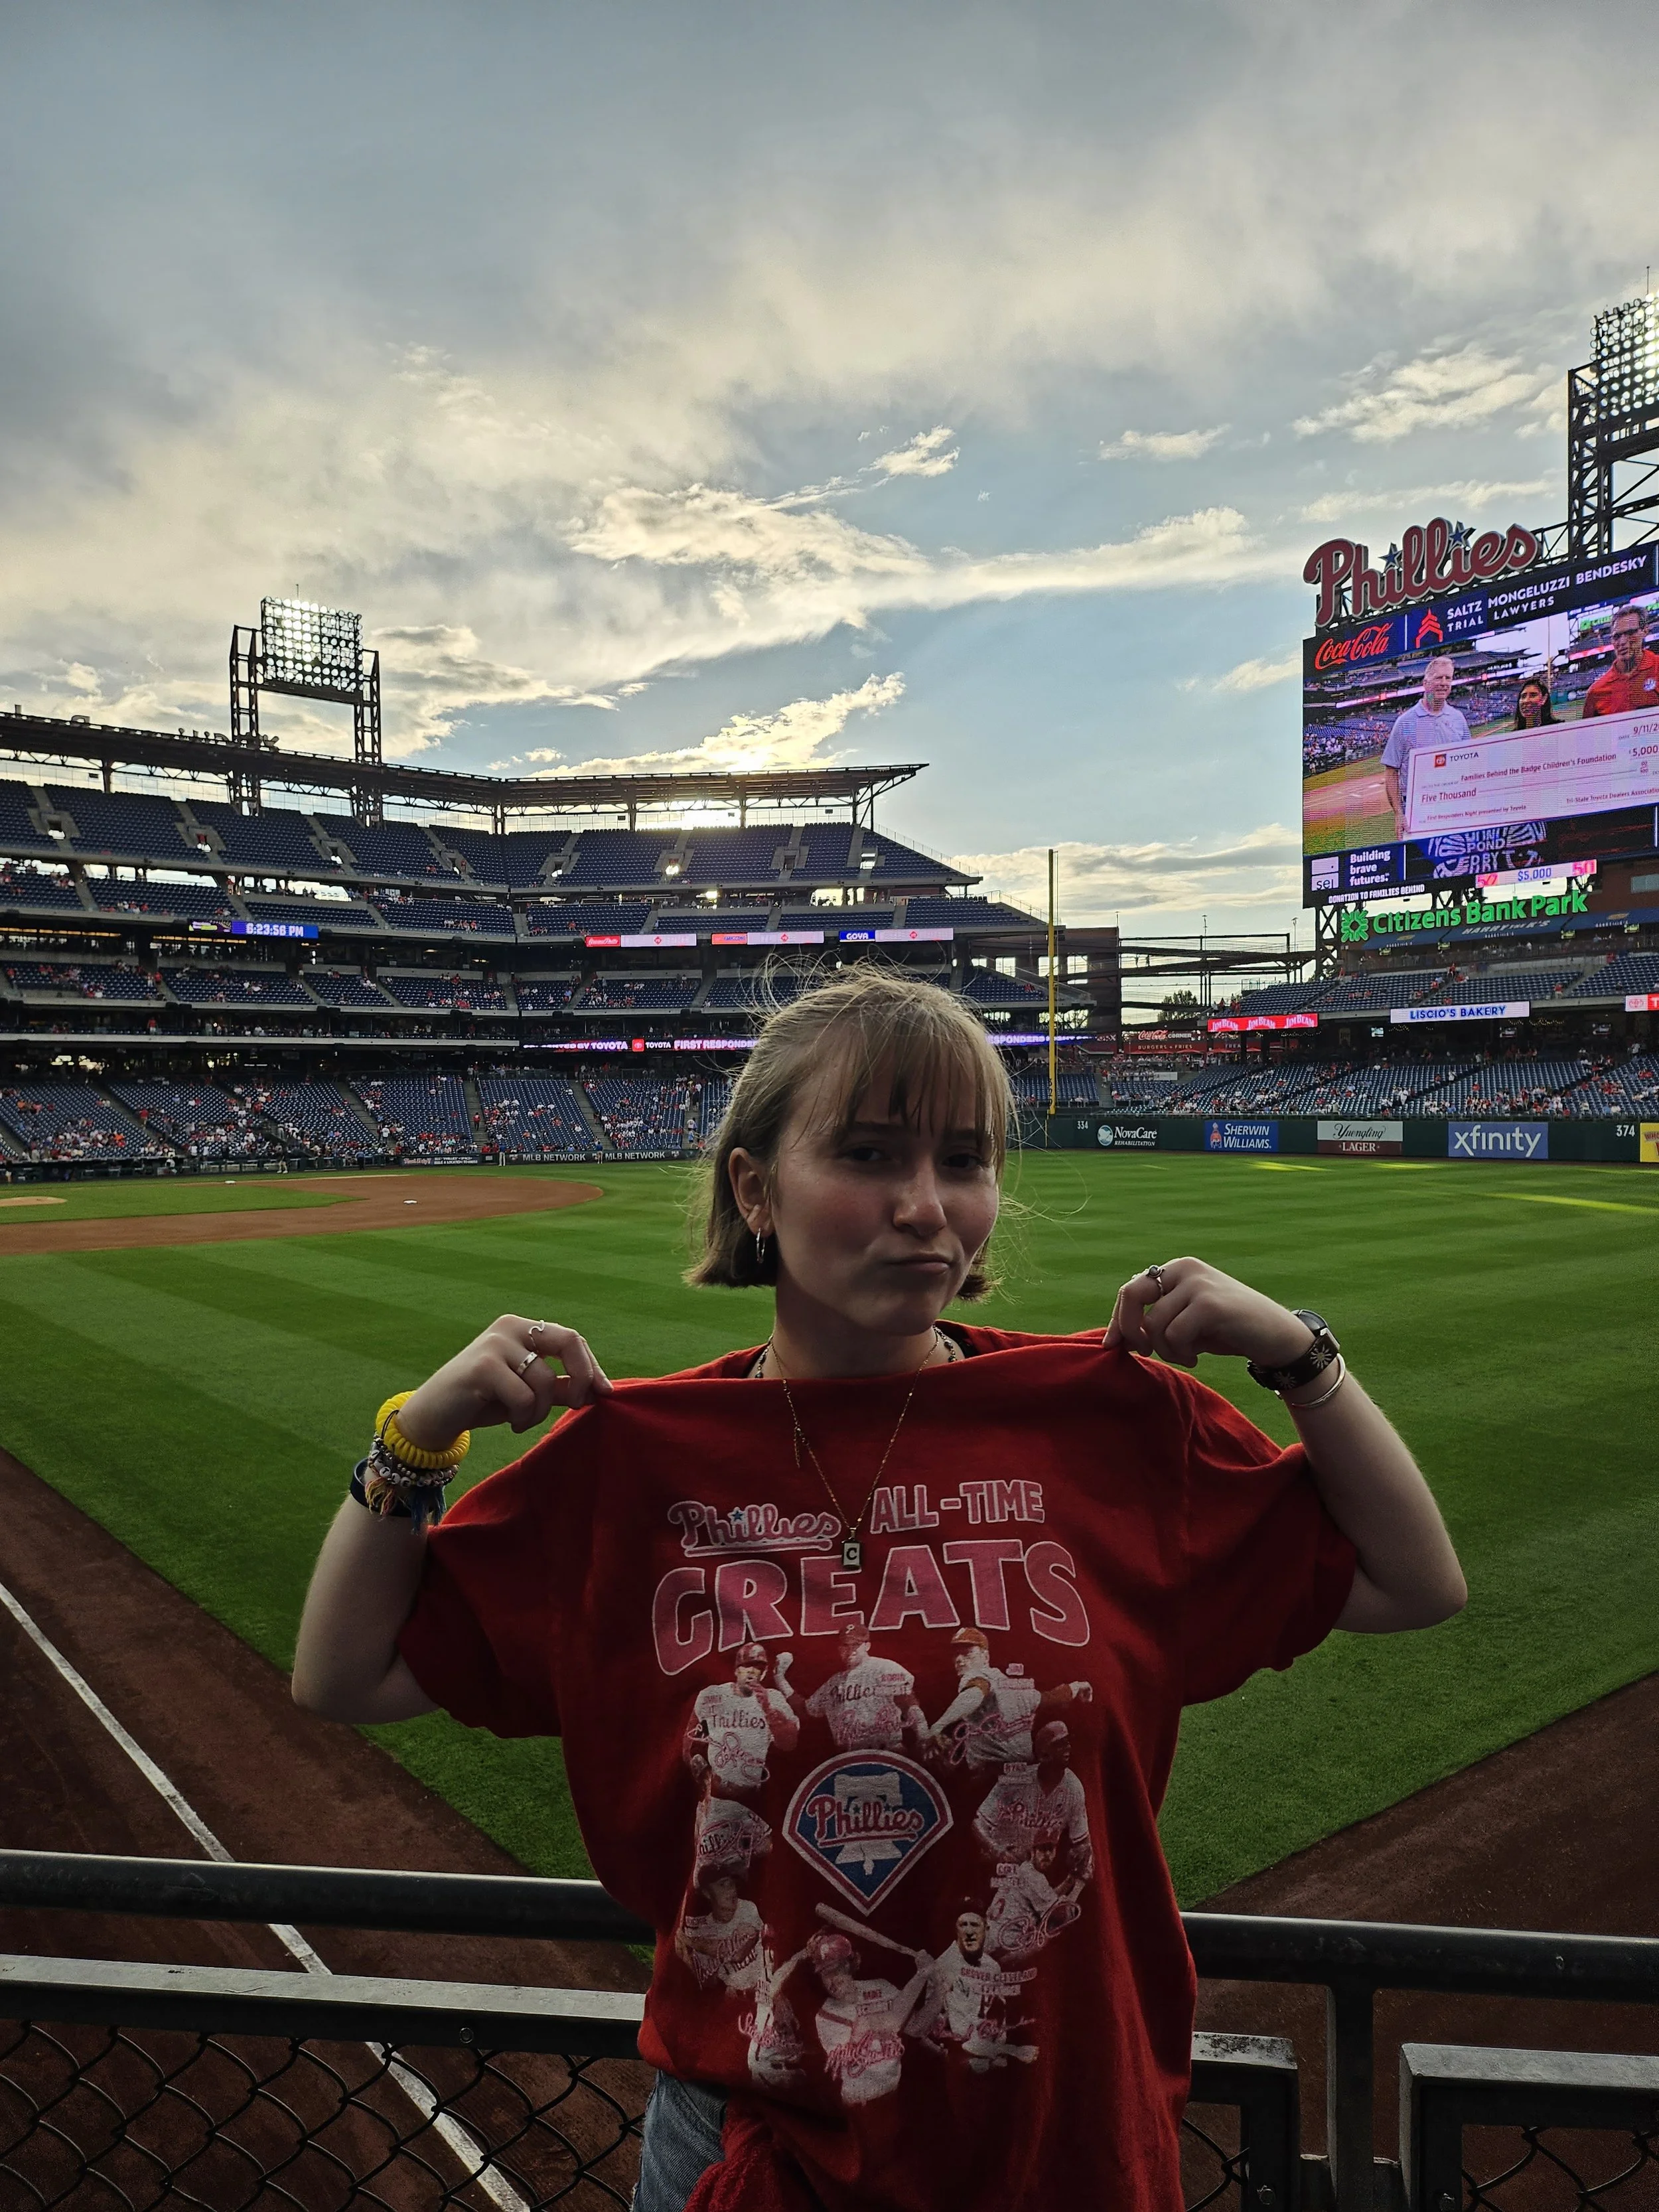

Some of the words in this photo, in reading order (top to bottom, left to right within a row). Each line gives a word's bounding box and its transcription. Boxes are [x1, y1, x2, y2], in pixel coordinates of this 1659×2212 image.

[1303, 516, 1539, 627] Phillies
[1447, 601, 1482, 620] SALTZ
[1487, 577, 1569, 609] MONGELUZZI
[1576, 555, 1648, 585] BENDESKY
[1447, 615, 1484, 632] TRIAL
[1493, 596, 1555, 621] LAWYERS
[1315, 622, 1394, 670] Coca-Cola
[1450, 752, 1479, 762] TOYOTA
[1486, 769, 1508, 778] Behind
[1521, 765, 1541, 773] Badge
[1543, 759, 1575, 770] Children's
[1577, 753, 1617, 765] Foundation
[1421, 794, 1437, 803] Five
[1439, 788, 1477, 800] Thousand
[1350, 849, 1391, 863] Building
[1350, 863, 1378, 875] brave
[1329, 892, 1359, 904] DONATION
[1360, 891, 1368, 901] TO
[1369, 887, 1400, 899] FAMILIES
[1401, 884, 1425, 895] BEHIND
[1373, 907, 1462, 934] Citizens
[1466, 896, 1527, 924] Bank
[1531, 889, 1589, 918] Park
[289, 925, 304, 937] PM
[1410, 1007, 1457, 1019] LISCIO'S
[1461, 1005, 1506, 1017] BAKERY
[1222, 1019, 1239, 1029] BEAM
[1258, 1017, 1275, 1029] BEAM
[1297, 1015, 1315, 1027] BEAM
[591, 1041, 628, 1050] TOYOTA
[674, 1039, 702, 1050] FIRST
[985, 1035, 1045, 1044] ESPONDERS
[1077, 1120, 1088, 1130] 334
[1224, 1123, 1270, 1136] SHERWIN
[1333, 1123, 1387, 1140] Yuengling
[1616, 1124, 1636, 1137] 374
[1114, 1126, 1157, 1140] NovaCare
[1342, 1142, 1377, 1153] LAGER
[1454, 1124, 1542, 1158] xfinity
[869, 1479, 1046, 1535] ALL-TIME
[667, 1499, 842, 1558] Phillies
[845, 1547, 857, 1560] C
[652, 1538, 1090, 1676] GREATS
[806, 1793, 925, 1847] Phillies
